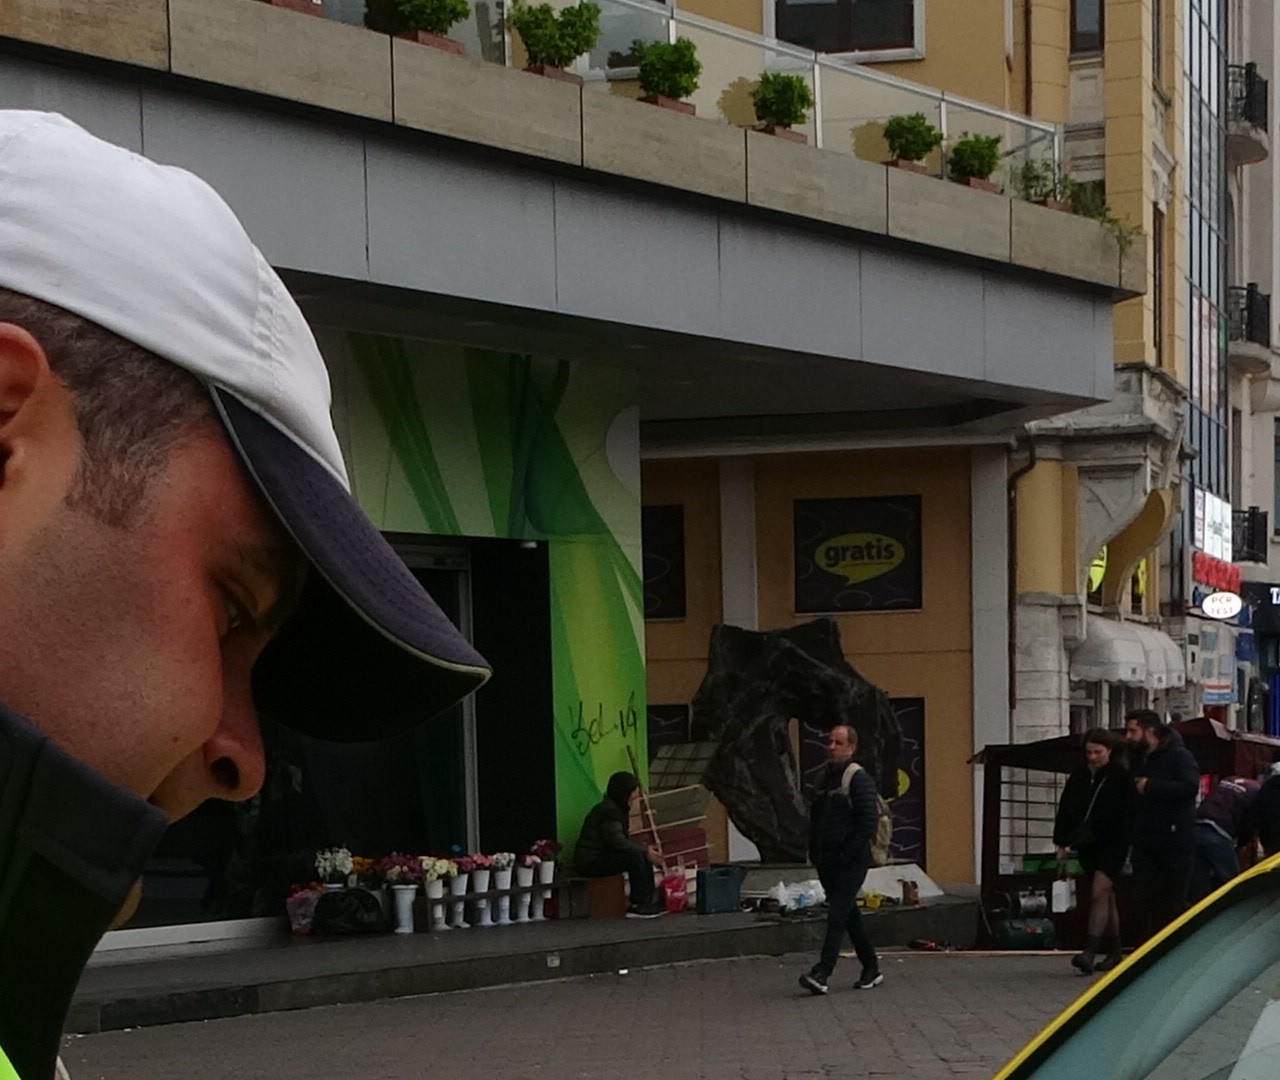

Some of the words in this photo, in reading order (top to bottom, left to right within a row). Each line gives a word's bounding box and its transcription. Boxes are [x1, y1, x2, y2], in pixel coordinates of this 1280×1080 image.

[824, 538, 896, 568] gratis
[1211, 595, 1233, 605] PCR
[1210, 606, 1234, 615] TEST
